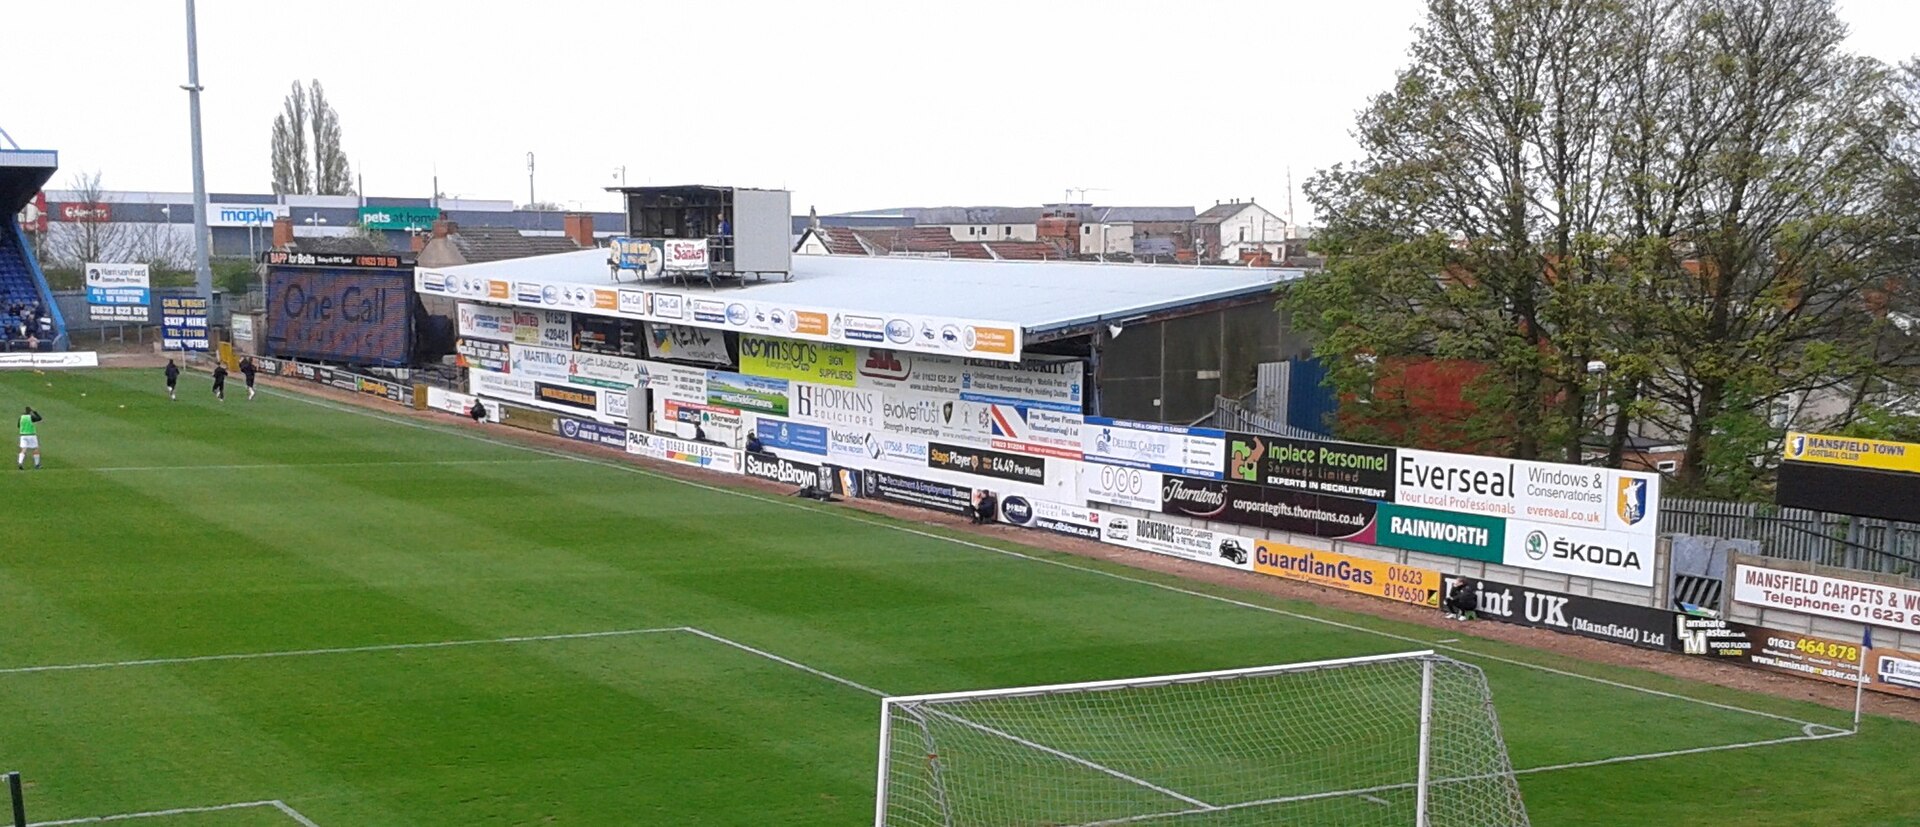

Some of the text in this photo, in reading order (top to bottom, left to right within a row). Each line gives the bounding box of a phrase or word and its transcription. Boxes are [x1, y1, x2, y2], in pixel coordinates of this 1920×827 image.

[221, 208, 275, 223] maplin
[363, 212, 391, 225] pets
[393, 212, 404, 222] at
[271, 252, 288, 263] BAPP
[289, 253, 298, 263] for
[298, 253, 316, 264] Bolts
[283, 283, 387, 323] One Call
[164, 317, 207, 327] SKIP HIRE
[513, 309, 539, 328] UNITED
[827, 355, 843, 366] SIGN
[819, 367, 853, 381] SUPPLIERS
[814, 386, 873, 414] HOPKINS
[711, 413, 740, 425] Sherwood
[814, 409, 874, 426] SOLICITORS
[883, 401, 940, 424] evolvetrust
[831, 430, 864, 446] Mansfield
[883, 421, 904, 433] Strength
[910, 425, 940, 437] partnership
[1268, 441, 1388, 473] Inplace Personnel
[1806, 449, 1860, 461] FOOTBALL CLUB
[1808, 437, 1905, 457] MANSFIELD TOWN
[747, 455, 817, 487] Sauce&Brown
[931, 448, 950, 464] Stags
[950, 450, 972, 468] Player
[992, 457, 1014, 474] £4.49
[1014, 464, 1024, 474] Per
[1024, 465, 1042, 478] Month
[1267, 462, 1360, 484] Services Limited
[878, 474, 888, 485] The
[887, 475, 916, 490] Recruitment
[920, 481, 952, 496] Employment
[1267, 476, 1388, 499] EXPERTS IN RECRUITMENT
[1399, 456, 1516, 499] Everseal
[1528, 466, 1603, 489] Windows &
[1162, 478, 1223, 506] Thorntons
[1400, 489, 1517, 516] Your Local Professionals
[1527, 484, 1603, 504] Conservatories
[1233, 498, 1366, 526] corporategifts.thorntons.co.uk
[1526, 505, 1601, 524] everseal.co.uk
[1136, 519, 1214, 543] ROCKFORCE CLASSIC CAMPER
[1390, 515, 1489, 547] RAINWORTH
[1180, 538, 1196, 548] RETRO
[1195, 540, 1212, 550] AUTOS
[1552, 537, 1642, 570] ŠKODA
[1256, 545, 1374, 585] GuardianGas
[1388, 566, 1422, 585] 01623
[1384, 581, 1425, 602] 819650
[1745, 569, 1819, 596] MANSFIELD
[1822, 580, 1884, 607] CARPETS
[1888, 591, 1898, 608] &
[1763, 589, 1846, 615] Telephone:
[1850, 604, 1905, 624] 01623
[1524, 591, 1570, 628] UK
[1571, 616, 1640, 644] (Mansfield)
[1641, 630, 1666, 646] Ltd
[1709, 641, 1752, 651] WOOD FLOOR
[1719, 649, 1743, 657] STUDIO
[1767, 637, 1857, 662] 01623 464 878
